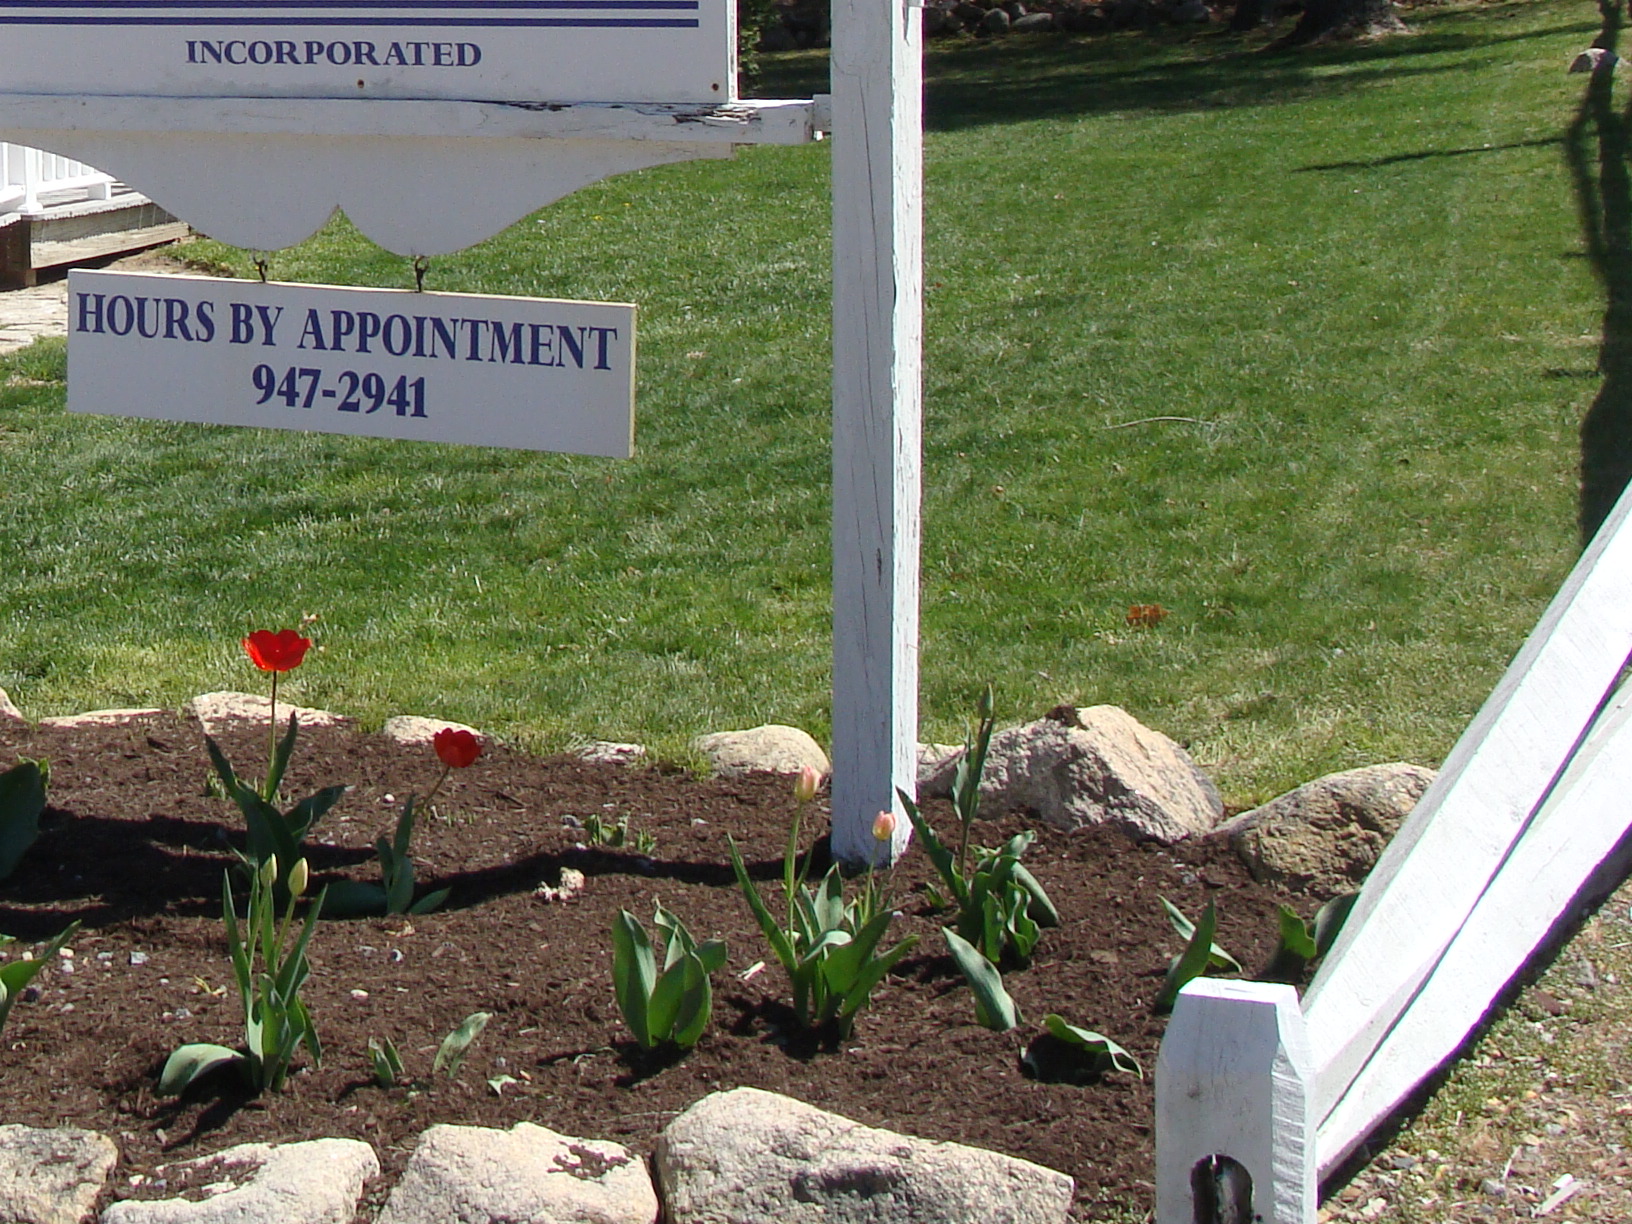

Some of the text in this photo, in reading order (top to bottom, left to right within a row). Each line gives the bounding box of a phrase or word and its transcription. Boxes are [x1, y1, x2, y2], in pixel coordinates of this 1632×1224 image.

[185, 40, 482, 67] INCORPORATED
[75, 291, 618, 371] HOURS BY APPOINTMENT
[251, 363, 429, 419] 947-2941
